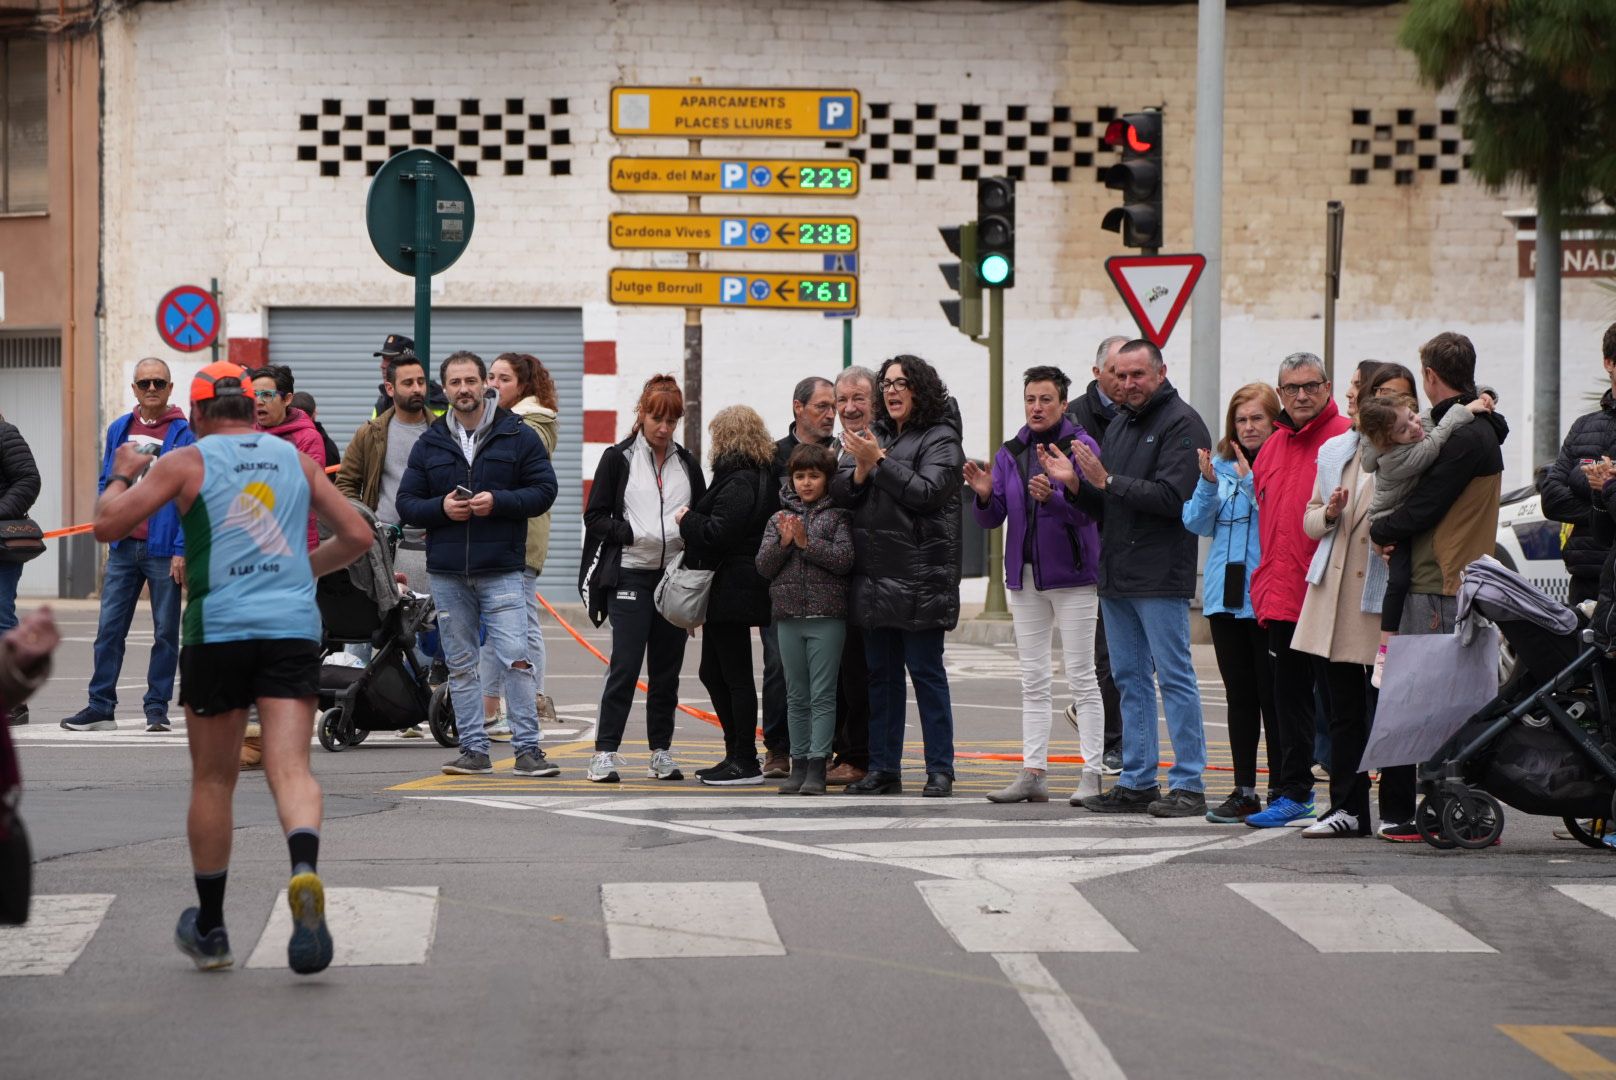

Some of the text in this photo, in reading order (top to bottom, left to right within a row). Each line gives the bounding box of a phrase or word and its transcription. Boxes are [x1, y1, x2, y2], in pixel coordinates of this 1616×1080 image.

[680, 96, 786, 109] APARCAMENTS
[826, 101, 845, 126] P
[675, 117, 793, 130] PLACES LLIURES
[616, 169, 662, 184] Avgda.
[666, 169, 687, 181] del
[691, 170, 717, 181] Mar
[800, 168, 852, 189] 229
[615, 225, 671, 238] Cardona
[675, 226, 711, 239] Vives
[799, 224, 851, 244] 238
[615, 281, 652, 295] Jutge
[657, 282, 703, 294] Borrull
[233, 462, 279, 473] VALENCIA
